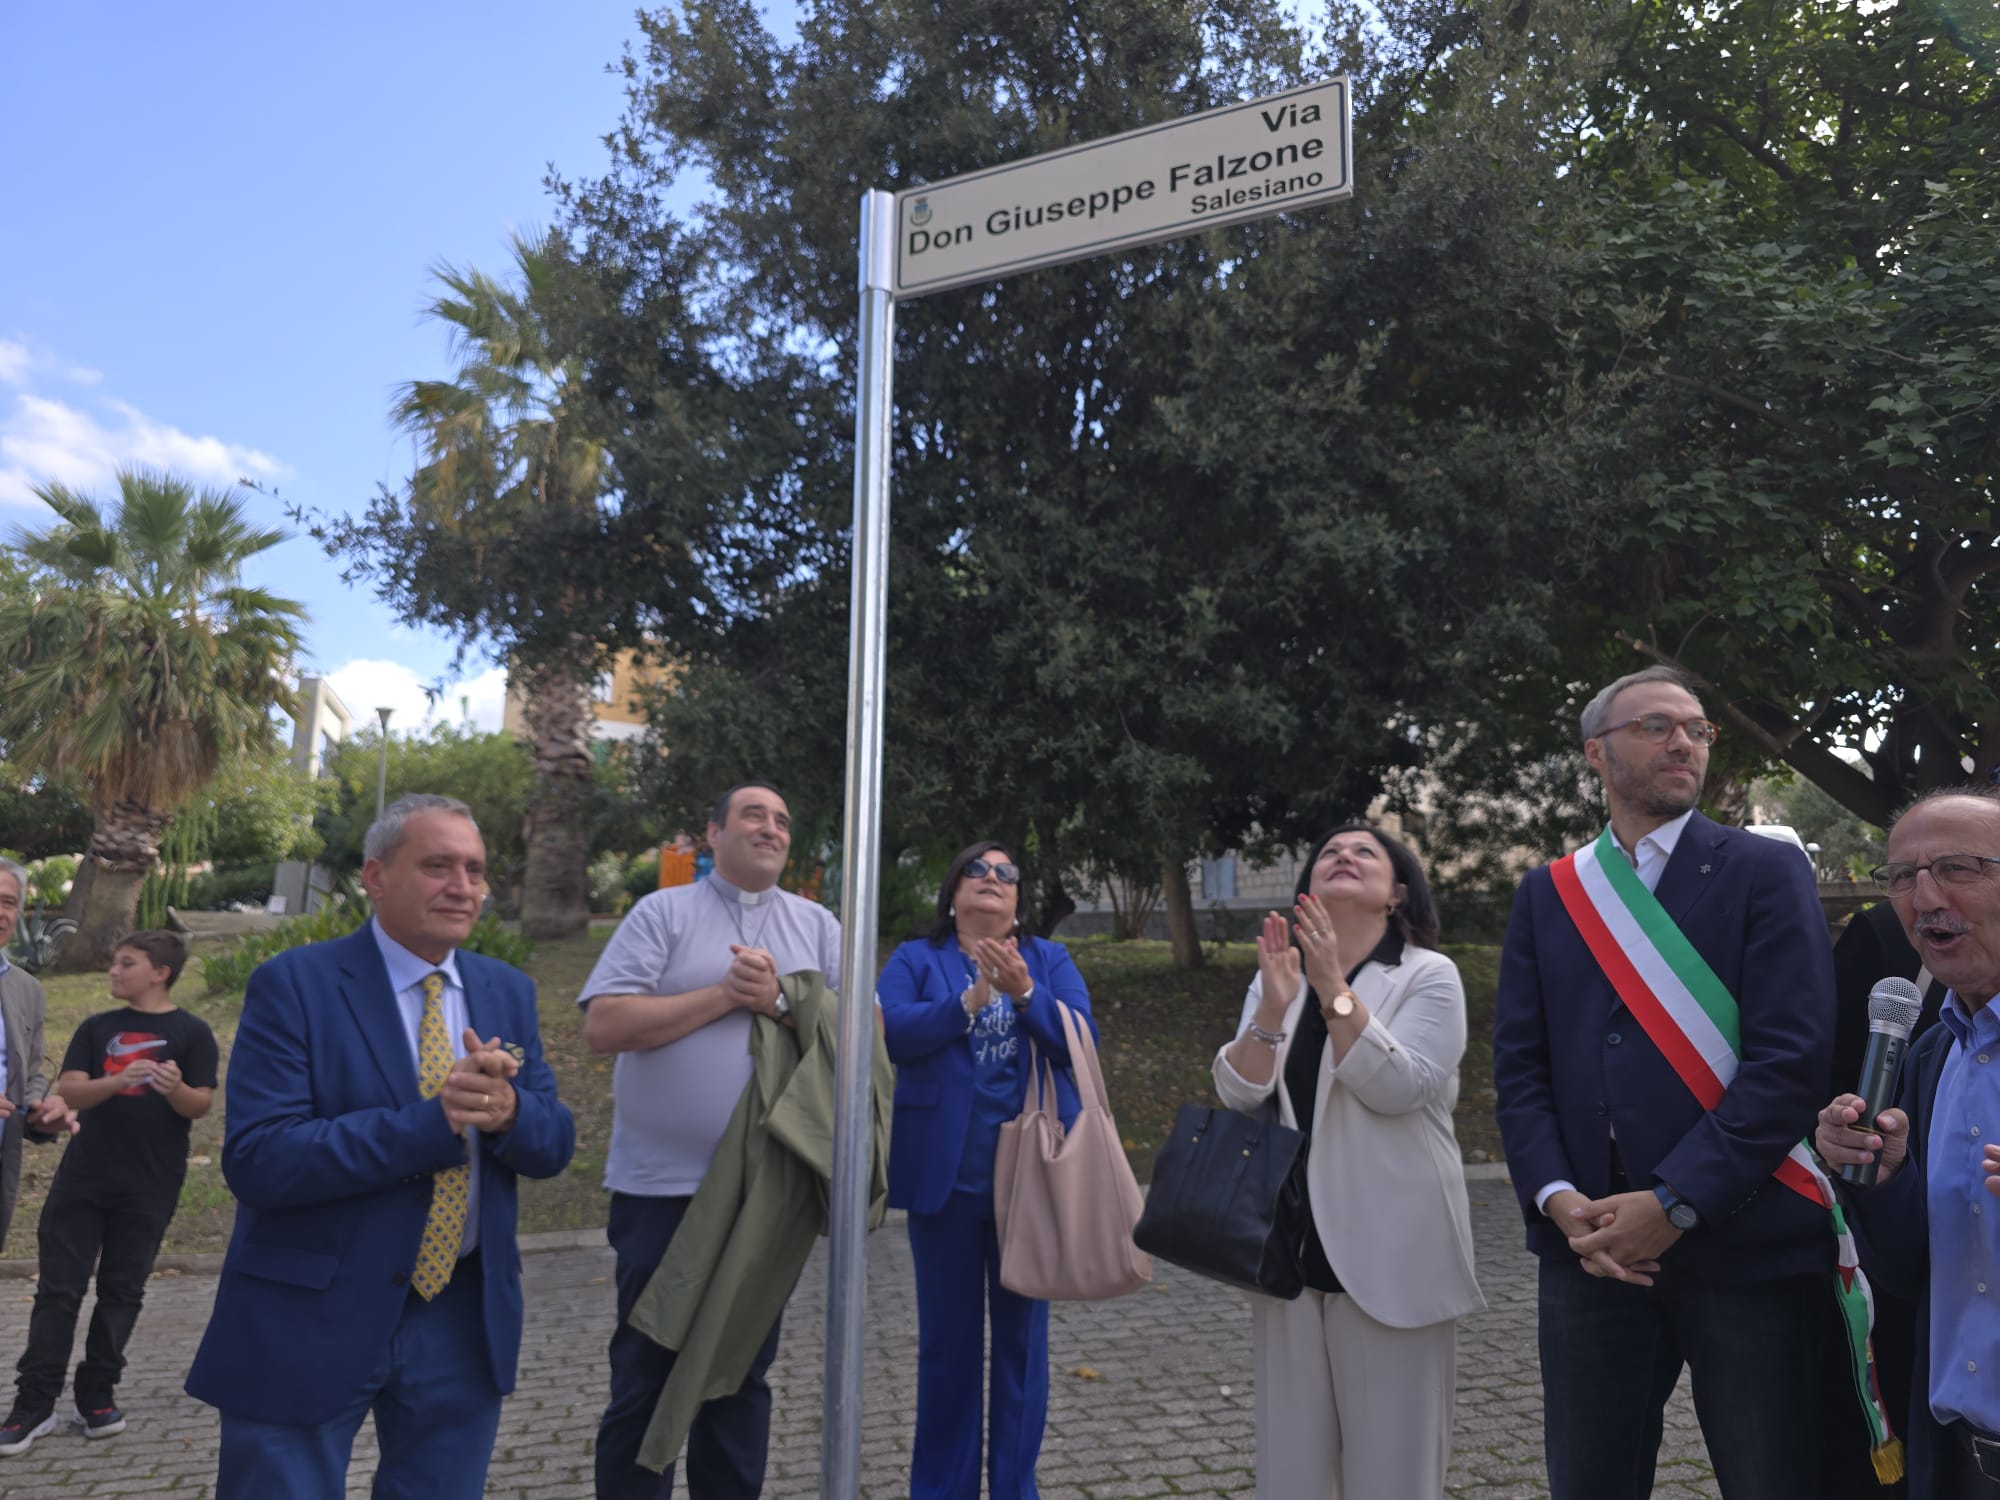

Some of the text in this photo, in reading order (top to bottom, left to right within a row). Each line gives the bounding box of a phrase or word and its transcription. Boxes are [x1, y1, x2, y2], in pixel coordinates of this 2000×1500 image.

[1260, 103, 1321, 132] Via
[909, 138, 1324, 256] Don Giuseppe Falzone
[1191, 172, 1323, 214] Salesiano
